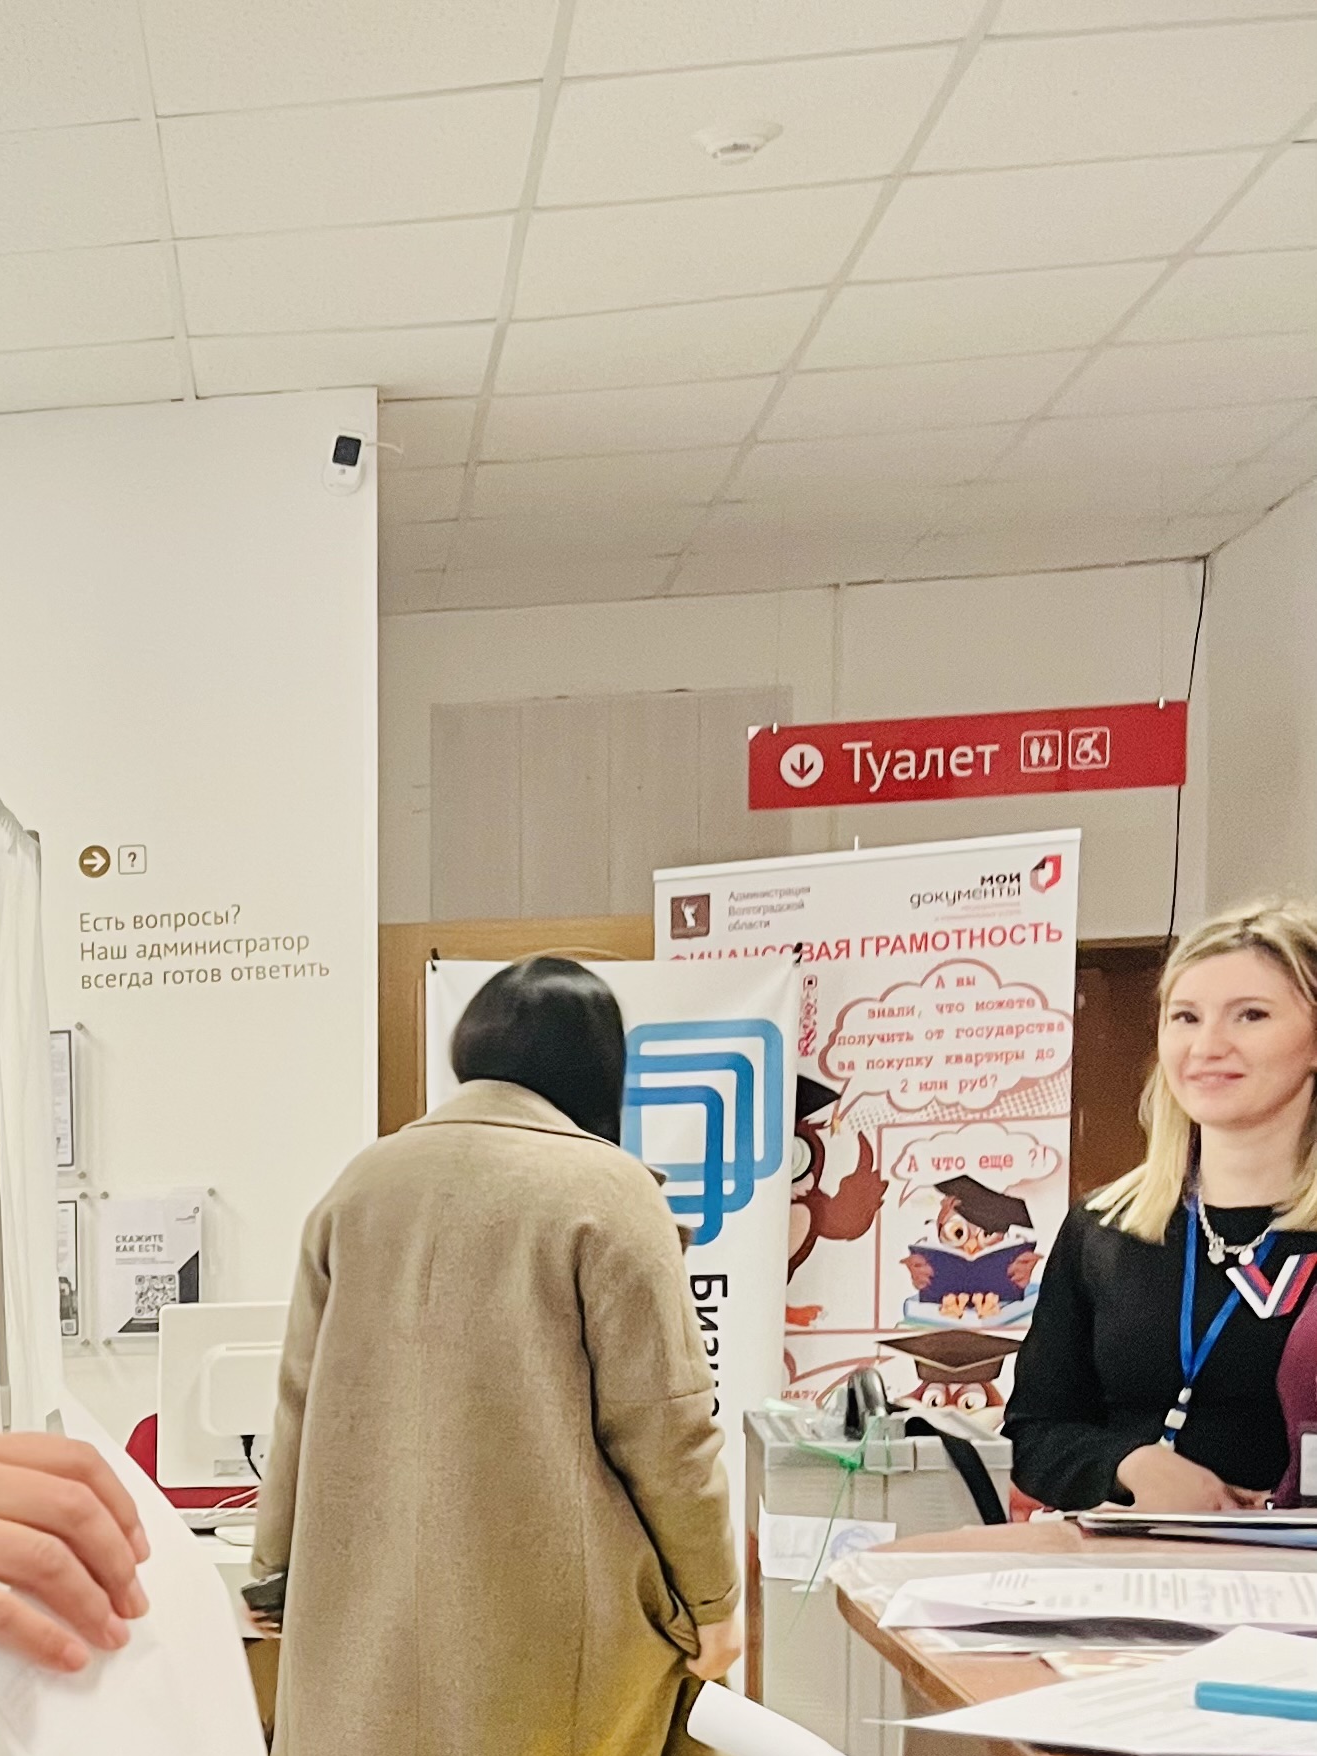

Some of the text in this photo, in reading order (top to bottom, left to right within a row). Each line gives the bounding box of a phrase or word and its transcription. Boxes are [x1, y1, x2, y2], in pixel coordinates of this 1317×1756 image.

[842, 741, 1000, 793] Туалет
[909, 884, 1021, 909] документы
[79, 904, 241, 933] Есть вопросы?
[728, 919, 770, 932] области
[80, 935, 310, 961] Наш администратор
[860, 921, 1063, 957] ГРАМОТНОСТЬ
[81, 962, 330, 990] всегда готов ответить
[935, 975, 976, 989] А вы
[935, 1002, 965, 1015] что
[975, 998, 1036, 1012] можете
[837, 1021, 1066, 1048] получить от государства
[837, 1048, 1055, 1072] за покупку квартиры до
[899, 1078, 909, 1093] 2
[958, 1074, 999, 1095] руб?
[907, 1145, 1047, 1172] А что еще ?!
[115, 1233, 164, 1243] СКАЖИТЕ
[115, 1243, 164, 1253] КАК ЕСТЬ
